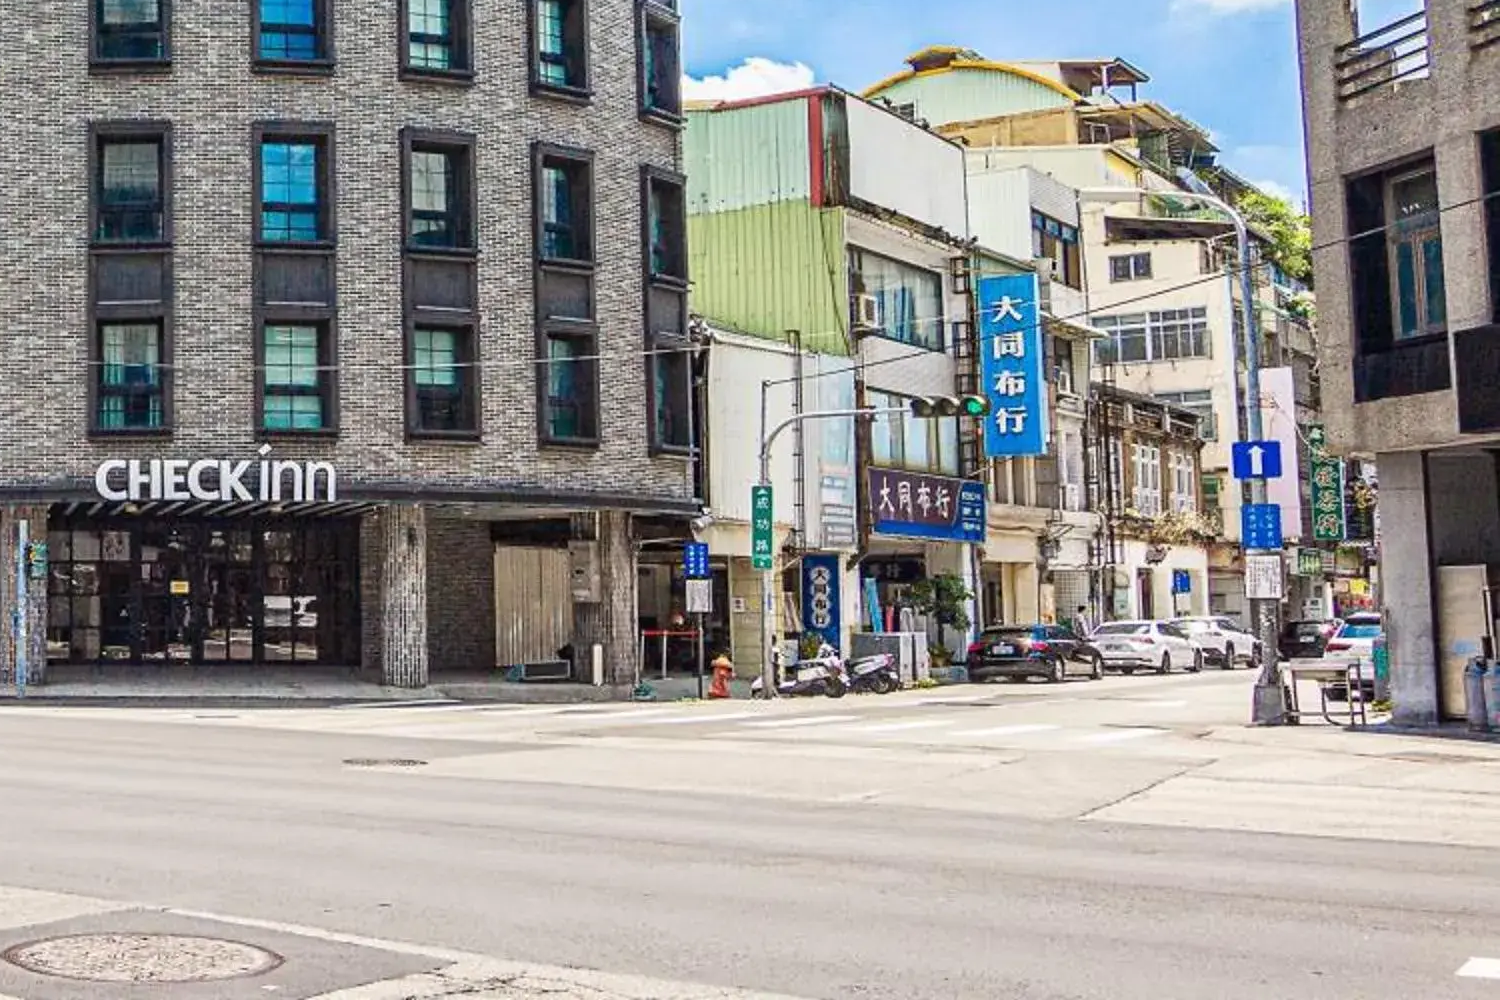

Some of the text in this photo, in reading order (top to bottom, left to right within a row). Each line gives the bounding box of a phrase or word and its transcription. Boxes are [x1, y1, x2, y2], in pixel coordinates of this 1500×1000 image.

[991, 295, 1028, 434] 大同布行
[756, 496, 770, 553] 成功路
[879, 476, 950, 520] 大同布行
